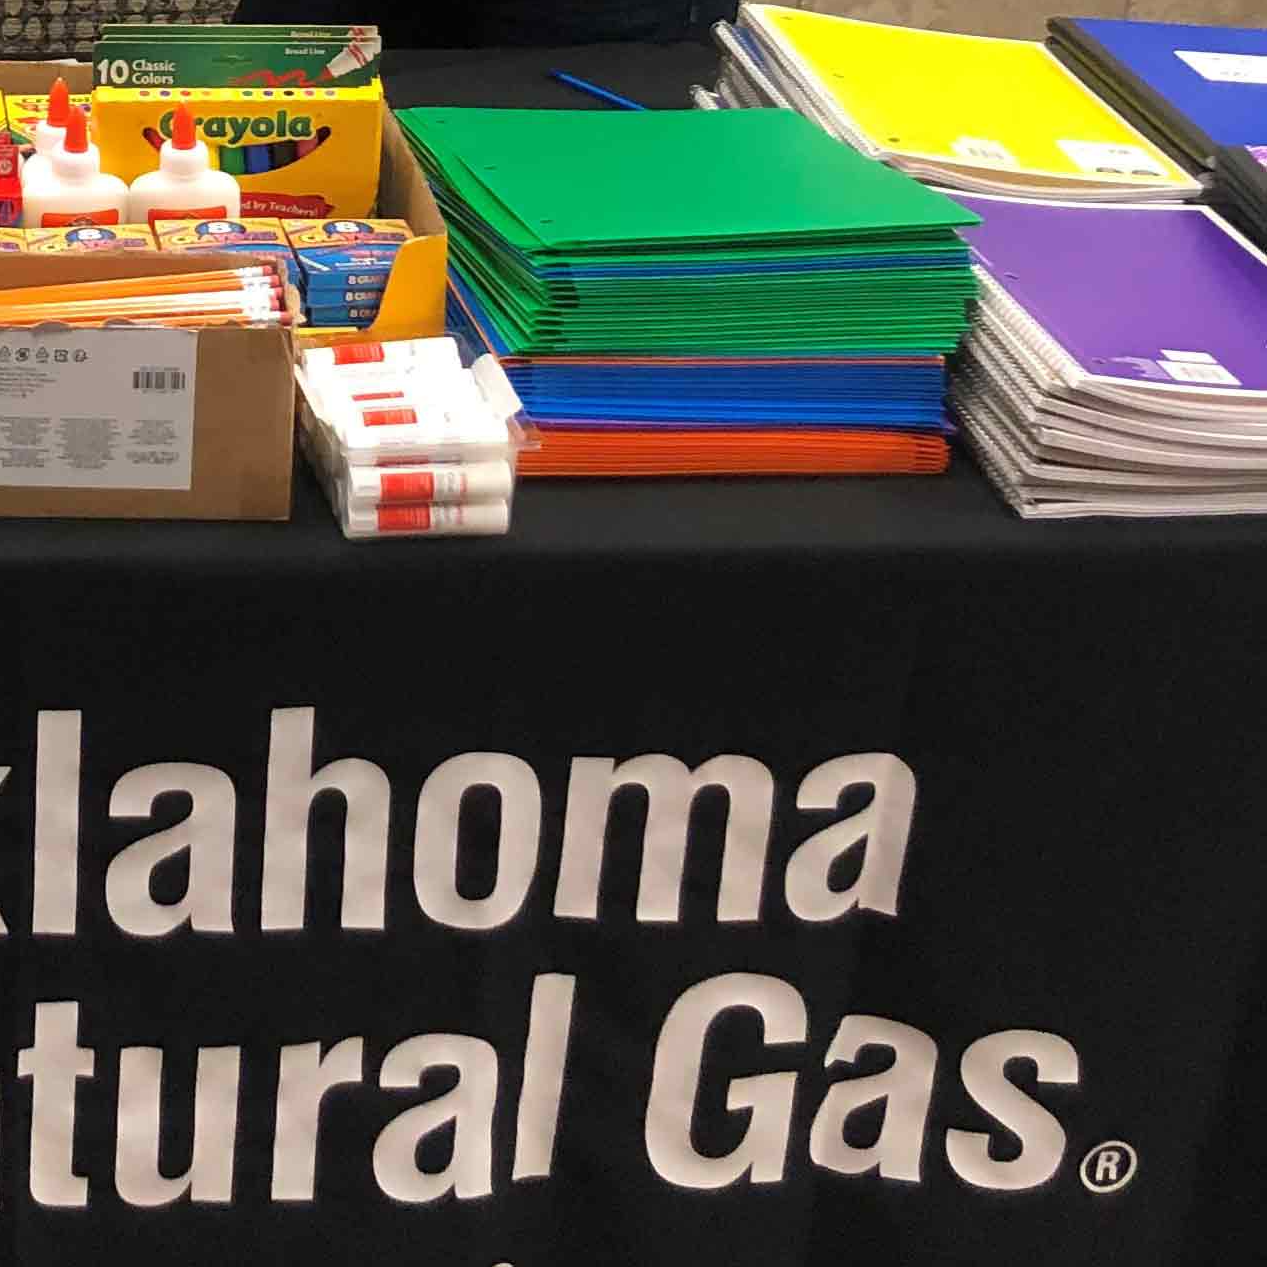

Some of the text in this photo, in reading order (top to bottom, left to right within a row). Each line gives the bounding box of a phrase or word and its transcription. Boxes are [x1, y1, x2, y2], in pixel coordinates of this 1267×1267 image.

[285, 48, 309, 56] Broad
[96, 58, 176, 85] 10 Classic
[131, 72, 174, 86] Colors
